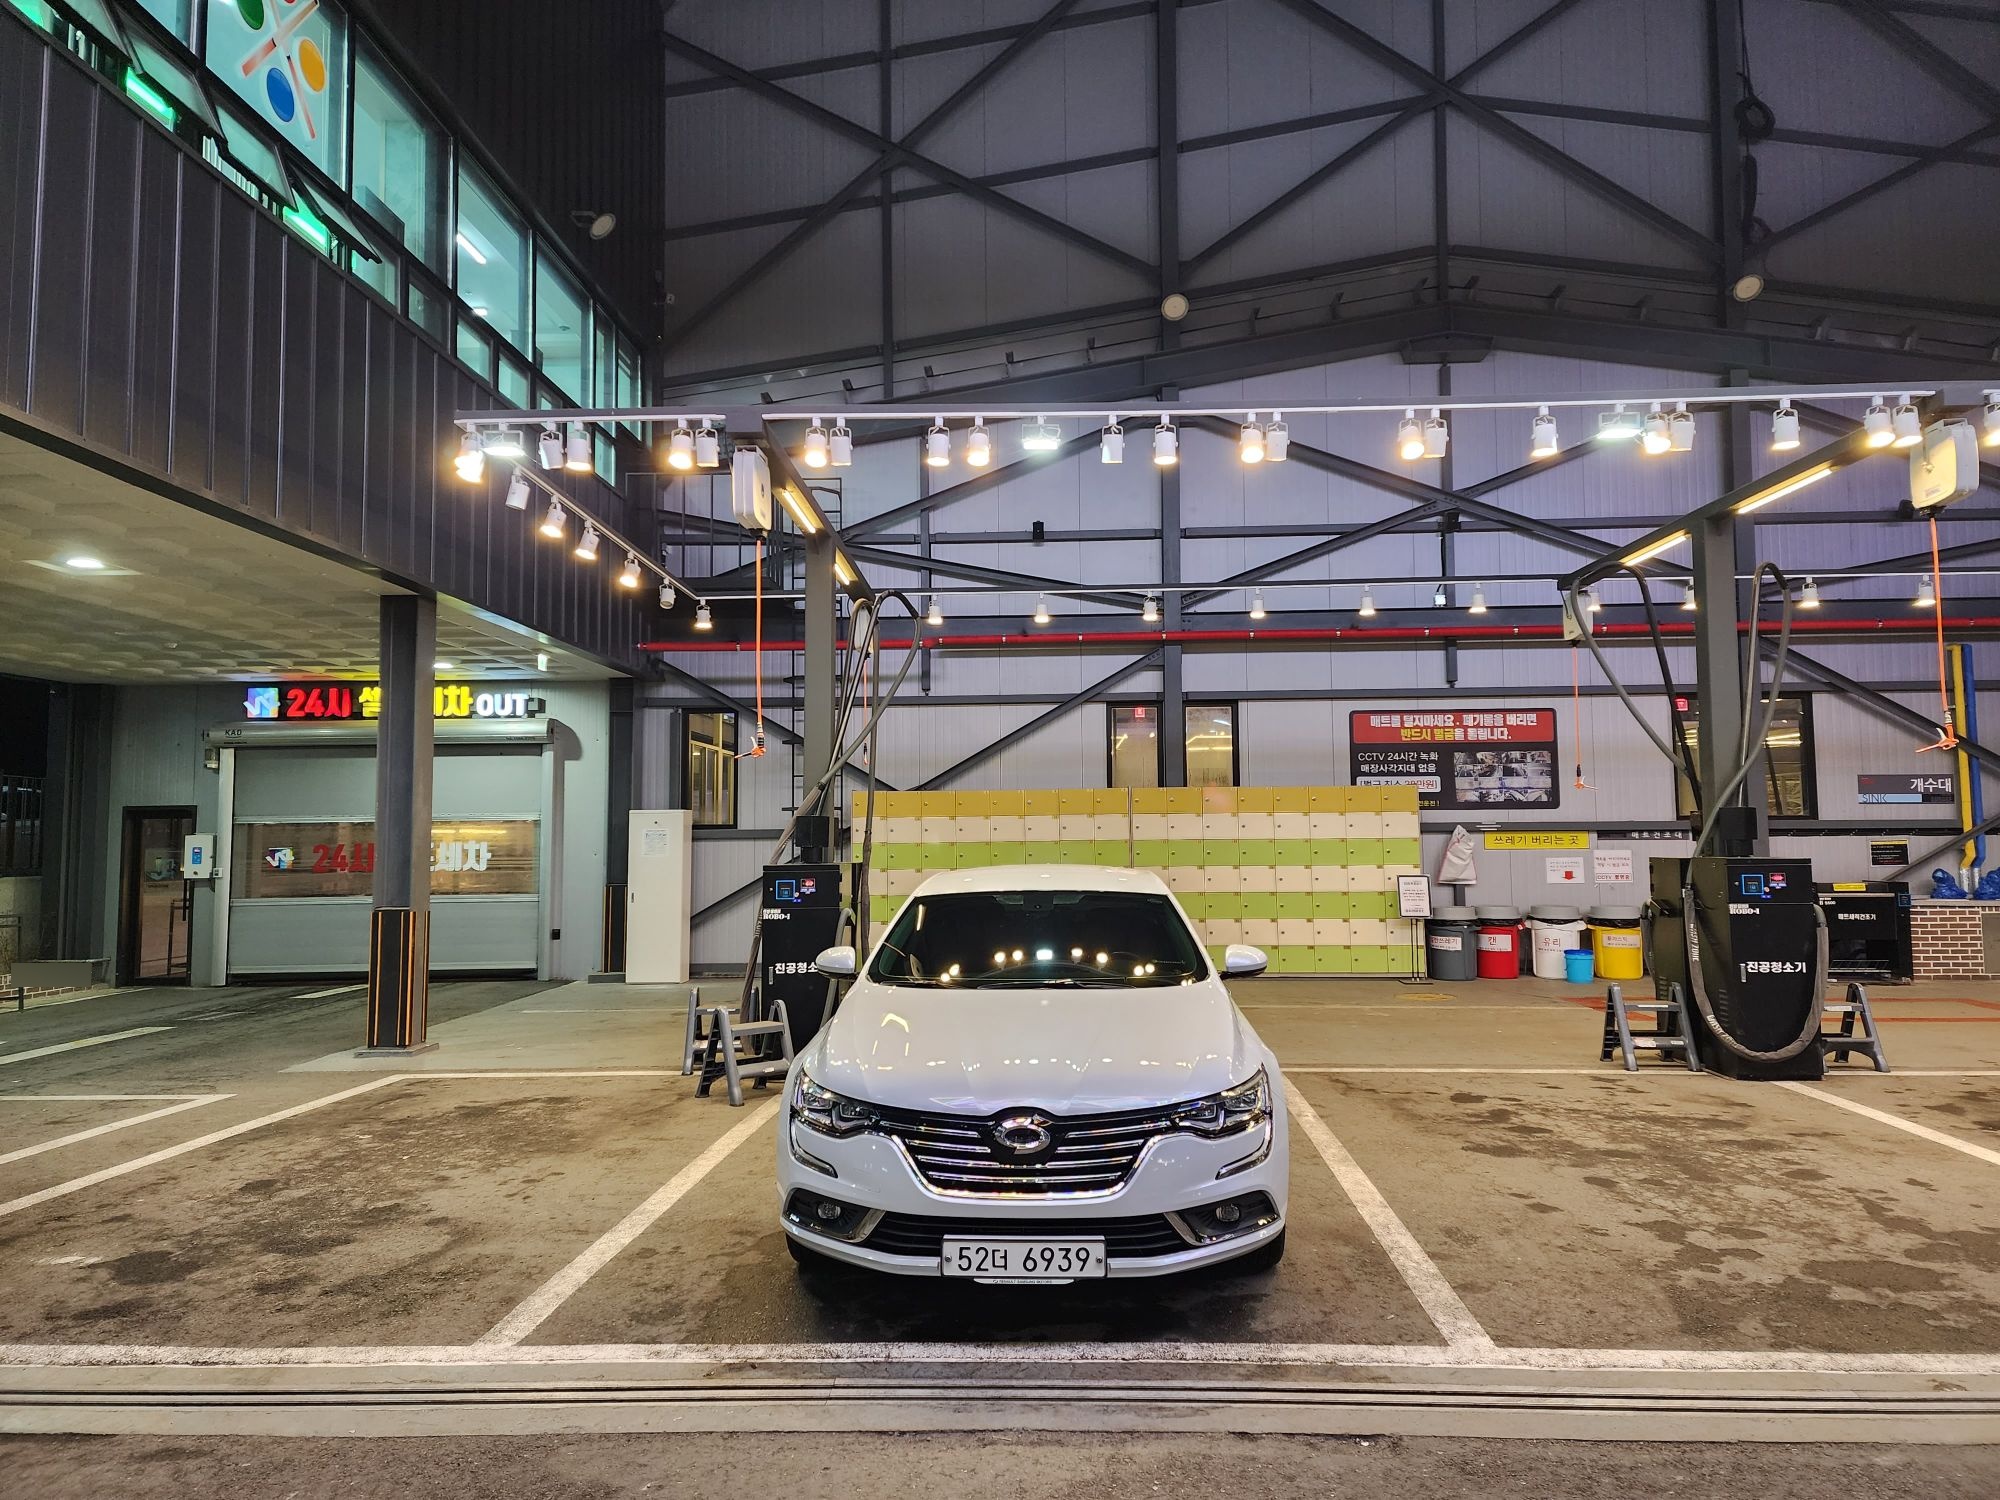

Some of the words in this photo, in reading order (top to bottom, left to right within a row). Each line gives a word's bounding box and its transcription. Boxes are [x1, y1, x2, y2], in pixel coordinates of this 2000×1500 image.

[286, 687, 352, 717] 24시
[476, 693, 530, 717] OUT
[1506, 714, 1538, 726] 버리면
[1401, 729, 1431, 741] 반드시
[1434, 728, 1464, 741] 벌금을
[1358, 752, 1385, 761] CCTV
[1387, 752, 1418, 761] 24시간
[1419, 752, 1439, 761] 녹화
[1361, 764, 1416, 773] 매장사각지대
[1418, 764, 1437, 773] 없음
[1910, 777, 1952, 793] 개수대
[1862, 793, 1887, 803] SINK
[1493, 835, 1527, 846] 쓰레기
[1531, 835, 1565, 846] 버리는
[1569, 835, 1580, 845] 곳
[313, 842, 375, 874] 24시
[1487, 937, 1497, 946] 캔
[1543, 938, 1561, 948] 유리
[775, 962, 818, 974] 진공청소
[1746, 961, 1807, 973] 진공청소기
[957, 1247, 1008, 1272] 52더
[1022, 1247, 1090, 1272] 6939
